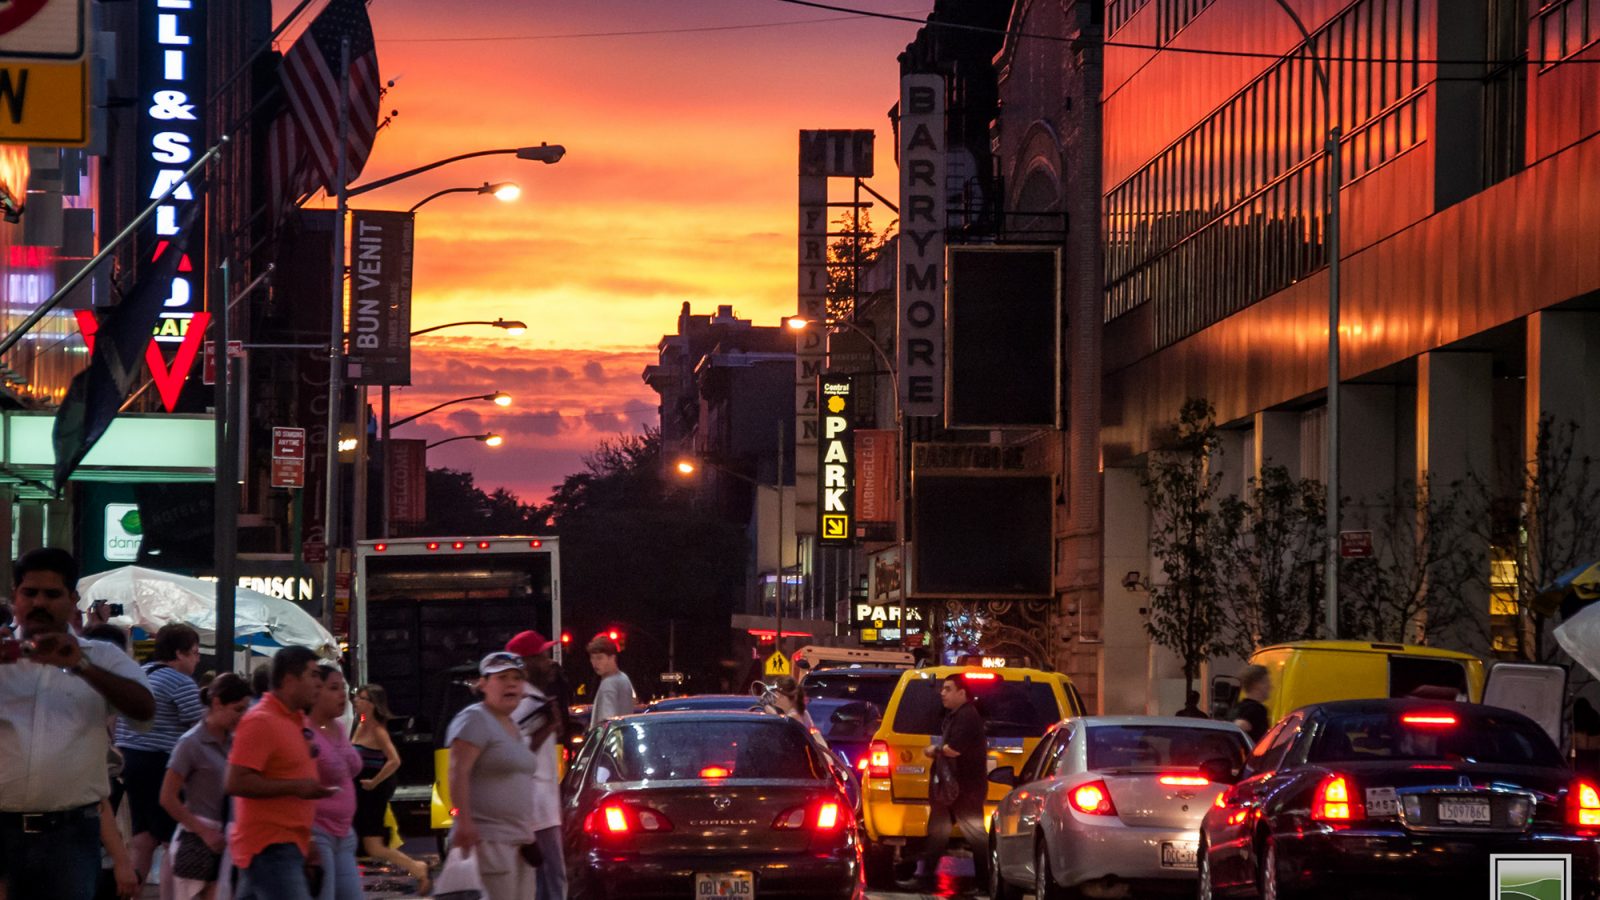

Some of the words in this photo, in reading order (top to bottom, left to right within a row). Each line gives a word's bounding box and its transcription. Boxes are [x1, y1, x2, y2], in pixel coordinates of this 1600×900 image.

[358, 219, 384, 291] VENIT
[906, 86, 937, 403] BARRYMORE
[356, 299, 381, 349] BUN
[824, 383, 849, 391] Central
[393, 444, 409, 520] WELCOME
[824, 416, 848, 511] PARK
[689, 818, 758, 826] COROLLA
